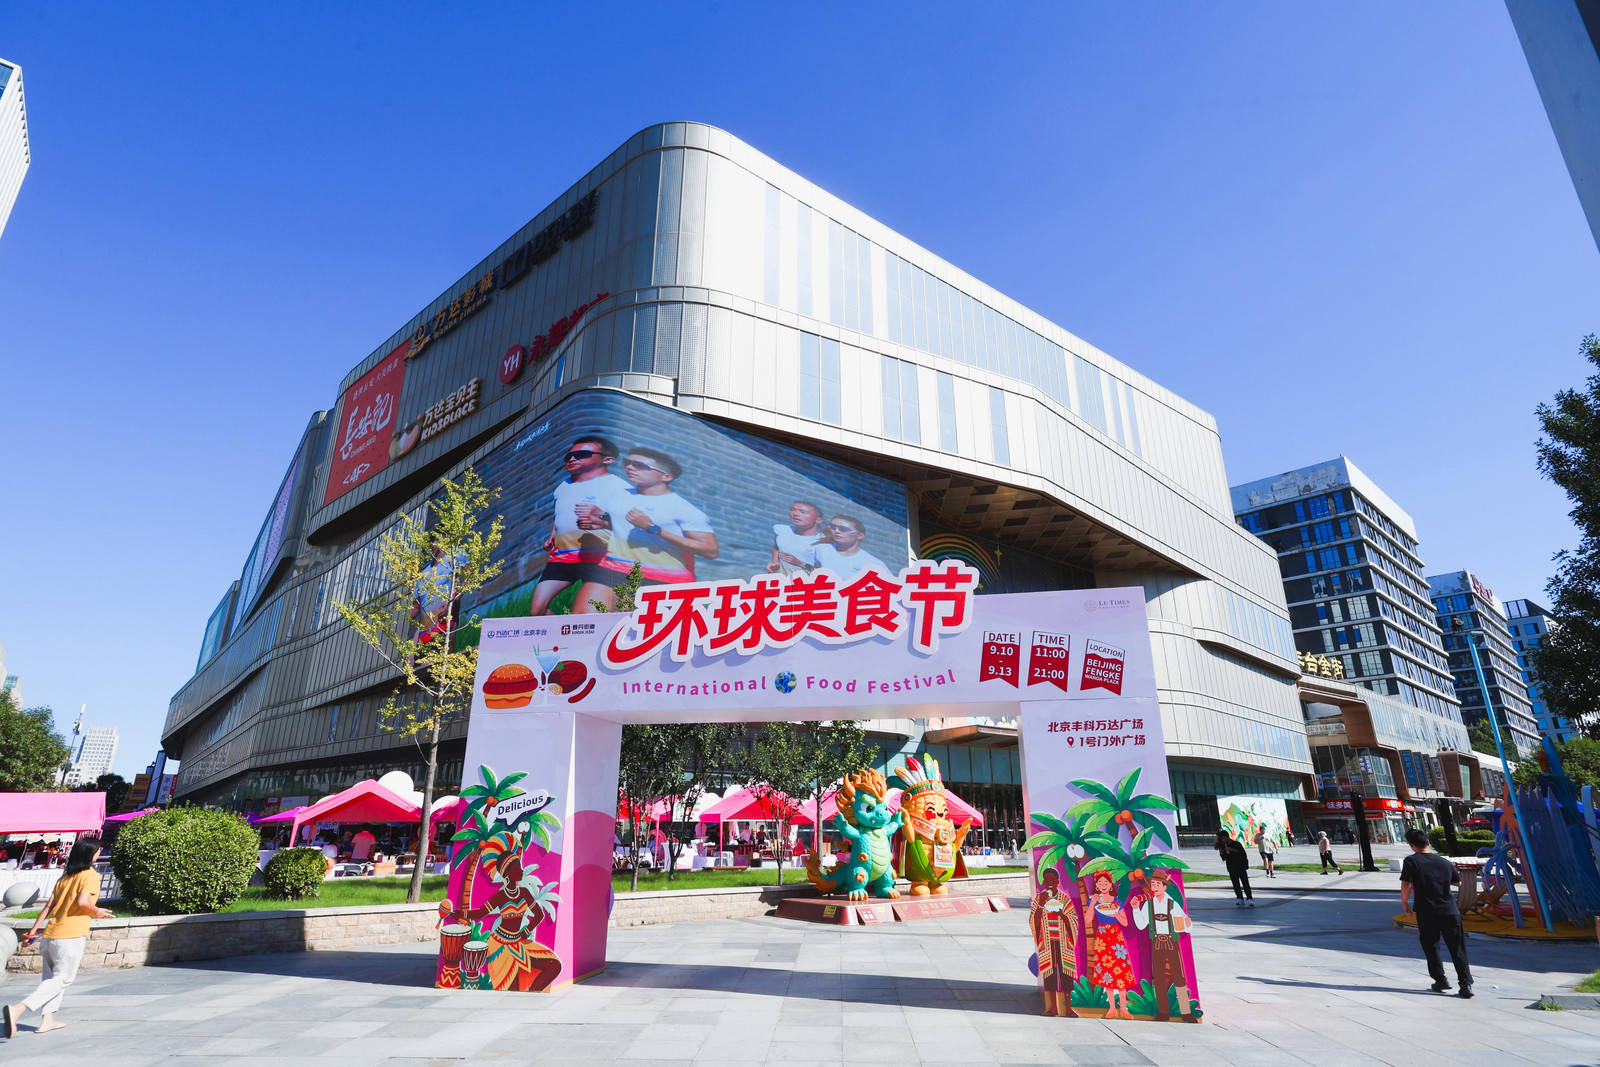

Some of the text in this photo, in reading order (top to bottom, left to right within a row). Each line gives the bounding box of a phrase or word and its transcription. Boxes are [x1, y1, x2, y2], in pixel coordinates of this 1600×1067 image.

[503, 351, 520, 376] YH
[423, 377, 478, 427] 万达宝贝王
[421, 399, 477, 442] KIDSPLACE
[607, 566, 972, 663] 环球美食节
[988, 632, 1016, 643] DATE
[1038, 633, 1065, 646] TIME
[989, 645, 1014, 656] 9.10
[1035, 647, 1066, 659] 11:00
[1090, 643, 1123, 658] LOCATION
[988, 665, 1012, 677] 9.13
[1086, 658, 1122, 672] BEIJING
[1033, 667, 1065, 679] 21:00
[1085, 666, 1120, 680] FENGKE
[623, 669, 956, 696] International Food Festival
[1048, 718, 1144, 733] 北京丰科万达广场
[1079, 735, 1146, 747] 1号门外广场
[497, 795, 544, 815] Delicious
